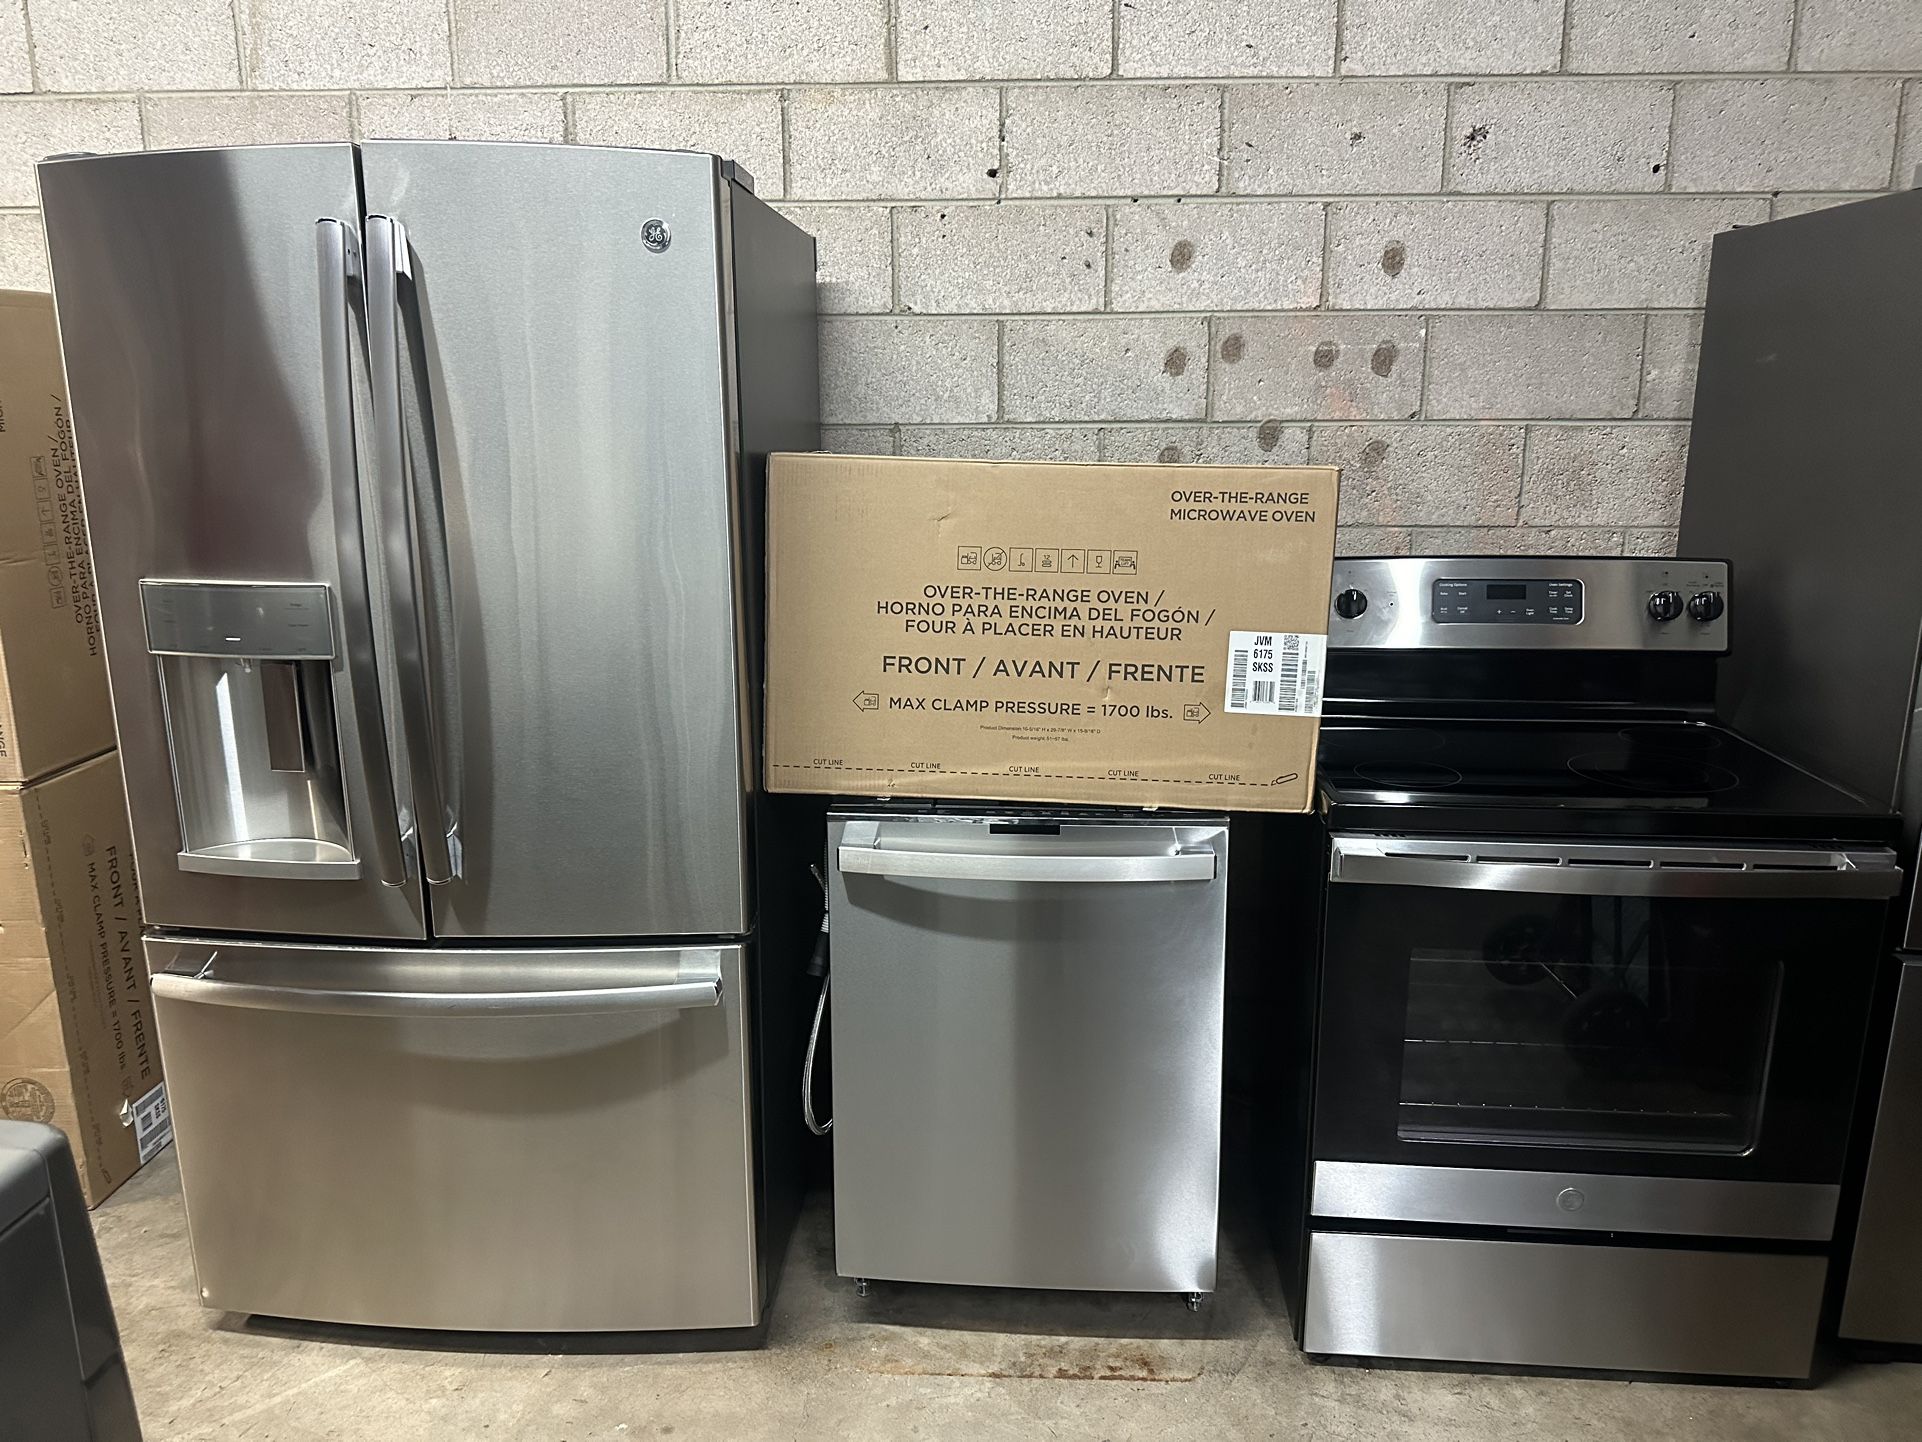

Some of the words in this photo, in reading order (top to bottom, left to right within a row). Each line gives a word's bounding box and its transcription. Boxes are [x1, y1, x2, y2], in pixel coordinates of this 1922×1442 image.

[54, 407, 69, 461] FOGÓN
[51, 448, 64, 488] OVEN
[64, 466, 75, 494] DEL
[1170, 490, 1310, 505] OVER-THE-RANGE
[69, 499, 84, 555] ENCIMA
[1169, 508, 1268, 522] MICROWAVE
[1271, 510, 1316, 523] OVEN
[59, 494, 84, 624] OVER-THE-RANGE
[78, 560, 89, 601] PARA
[923, 584, 1091, 603] OVER-THE-RANGE
[1096, 589, 1149, 605] OVEN
[877, 600, 945, 616] HORNO
[951, 603, 1003, 618] PARA
[1009, 604, 1081, 621] ENCIMA
[1088, 607, 1124, 622] DEL
[1130, 606, 1199, 624] FOGÓN
[84, 603, 97, 656] HORNO
[905, 619, 956, 634] FOUR
[961, 617, 975, 635] À
[981, 621, 1055, 638] PLACER
[1060, 623, 1085, 638] EN
[1091, 624, 1182, 641] HAUTEUR
[1254, 635, 1273, 646] JVM
[1252, 661, 1274, 673] SKSS
[1253, 648, 1273, 660] 6175
[882, 655, 966, 675] FRONT
[992, 659, 1081, 679] AVANT
[1107, 662, 1205, 683] FRENTE
[889, 697, 926, 710] MAX
[931, 698, 989, 712] CLAMP
[994, 700, 1081, 716] PRESSURE
[1101, 704, 1140, 718] 1700
[1145, 705, 1173, 719] lbs.
[926, 762, 941, 770] LINE
[1107, 769, 1121, 777] CUT
[87, 862, 99, 893] MAX
[93, 895, 106, 939] CLAMP
[99, 942, 117, 1008] PRESSURE
[106, 845, 124, 908] FRONT
[118, 930, 137, 991] AVANT
[131, 1009, 151, 1080] FRENTE
[112, 1020, 124, 1050] 1700
